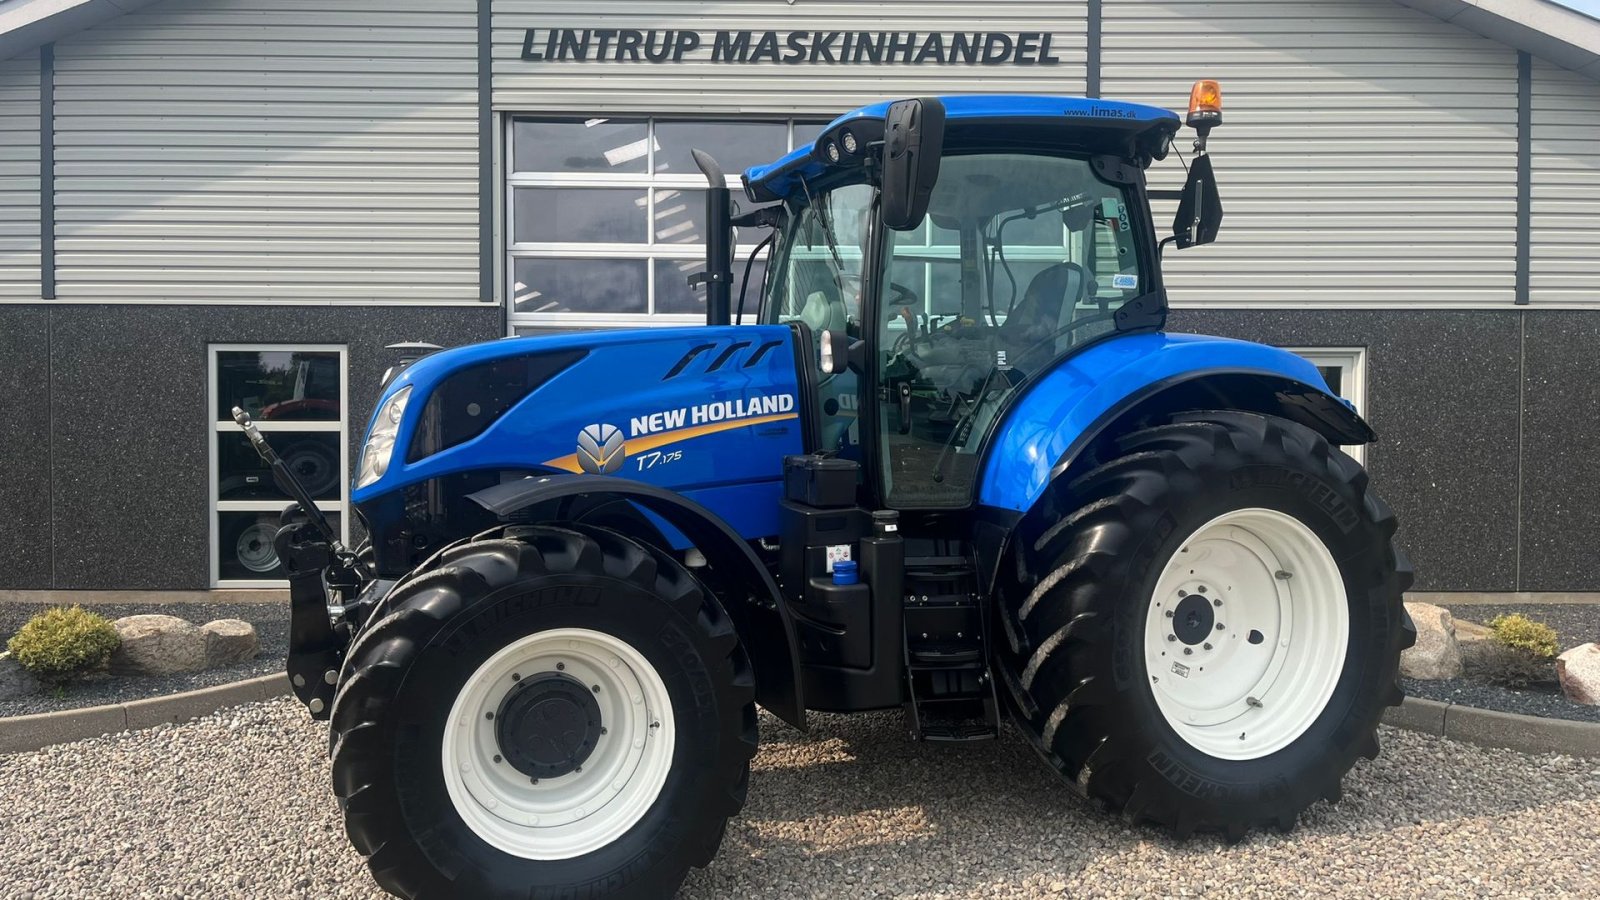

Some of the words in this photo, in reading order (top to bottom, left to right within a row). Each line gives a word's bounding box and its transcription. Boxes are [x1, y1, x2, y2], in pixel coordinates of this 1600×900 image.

[521, 28, 699, 62] LINTRUP
[711, 30, 1060, 65] MASKINHANDEL
[1063, 106, 1137, 119] www.limas.dk
[630, 408, 686, 437] NEW
[692, 393, 794, 425] HOLLAND
[636, 450, 683, 471] T7.175
